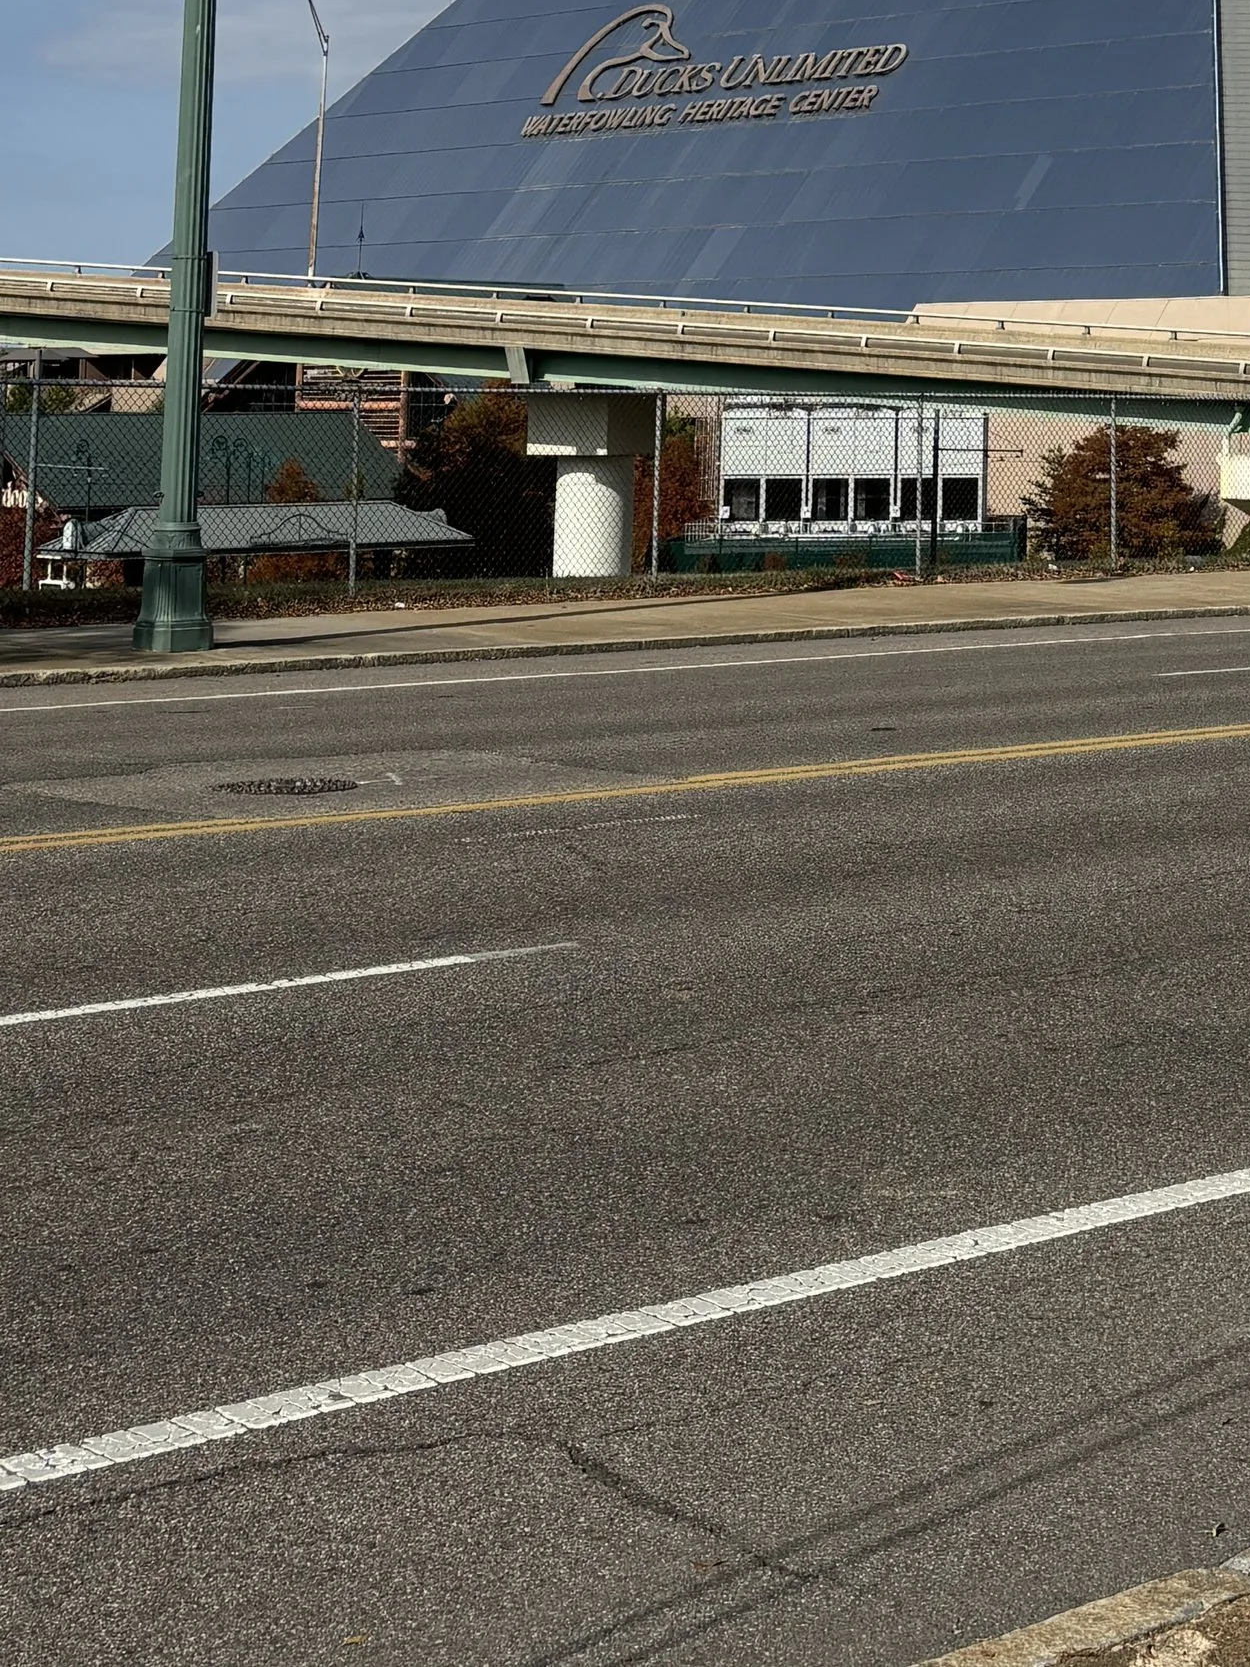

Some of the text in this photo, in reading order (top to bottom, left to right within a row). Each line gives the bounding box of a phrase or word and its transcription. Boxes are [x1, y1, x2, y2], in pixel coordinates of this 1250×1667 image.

[600, 43, 908, 101] DUCKS UNLIMITED
[521, 84, 879, 138] WATERFOWLING HERITAGE CENTER
